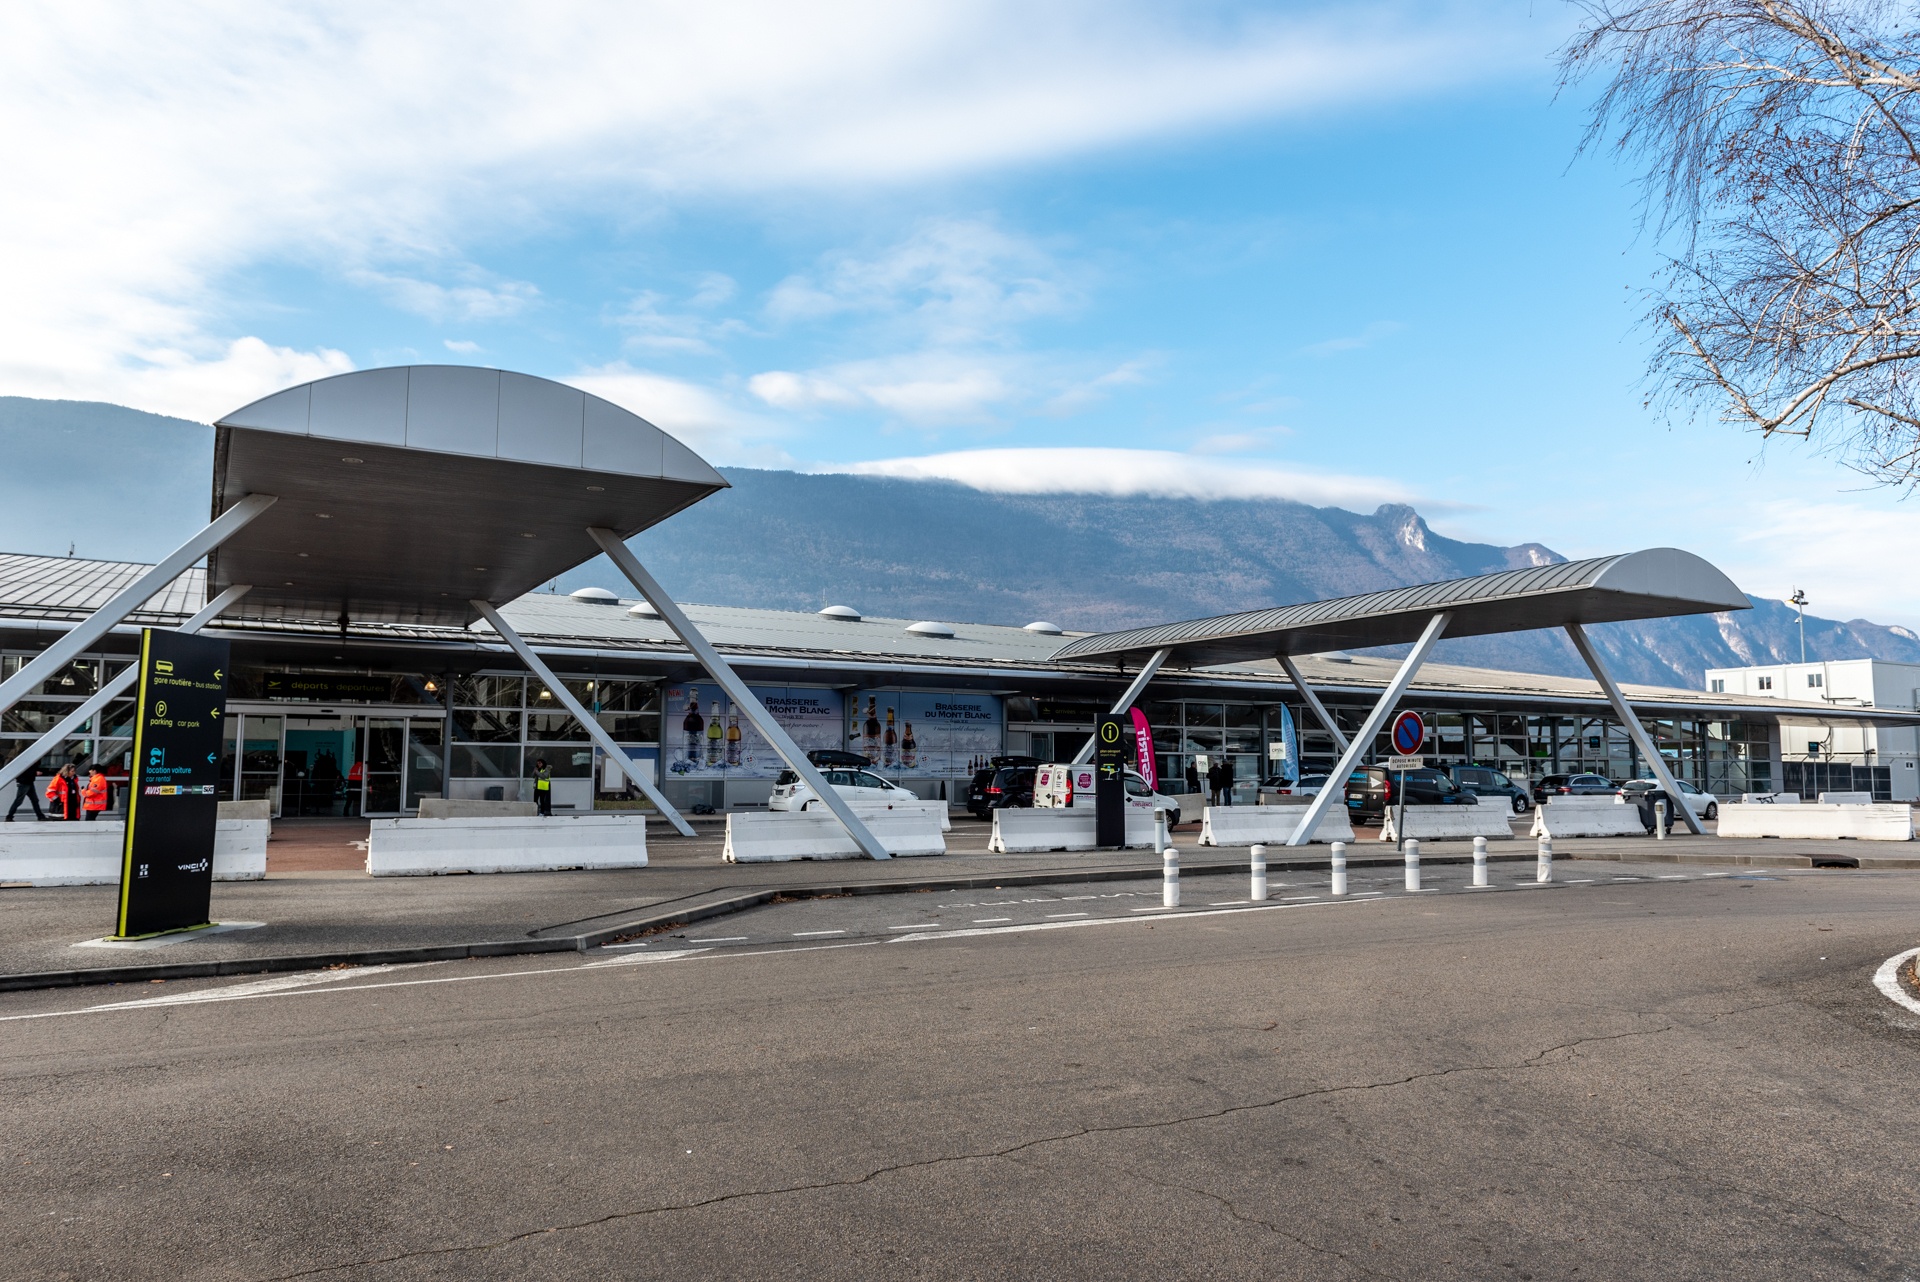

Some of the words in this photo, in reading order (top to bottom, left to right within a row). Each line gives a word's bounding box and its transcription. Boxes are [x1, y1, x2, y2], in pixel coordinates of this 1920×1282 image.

[153, 677, 168, 685] gare
[195, 681, 205, 689] bus
[205, 682, 222, 690] station
[291, 681, 329, 691] départs
[336, 683, 385, 692] departures
[765, 697, 819, 706] BRASSERIE
[769, 706, 797, 714] MONT
[935, 703, 982, 711] BRASSERIE
[964, 711, 991, 719] BLANC
[150, 718, 173, 727] parking
[187, 720, 200, 728] park
[146, 766, 171, 774] location
[144, 786, 160, 794] AVIS
[177, 863, 199, 871] VINCI
